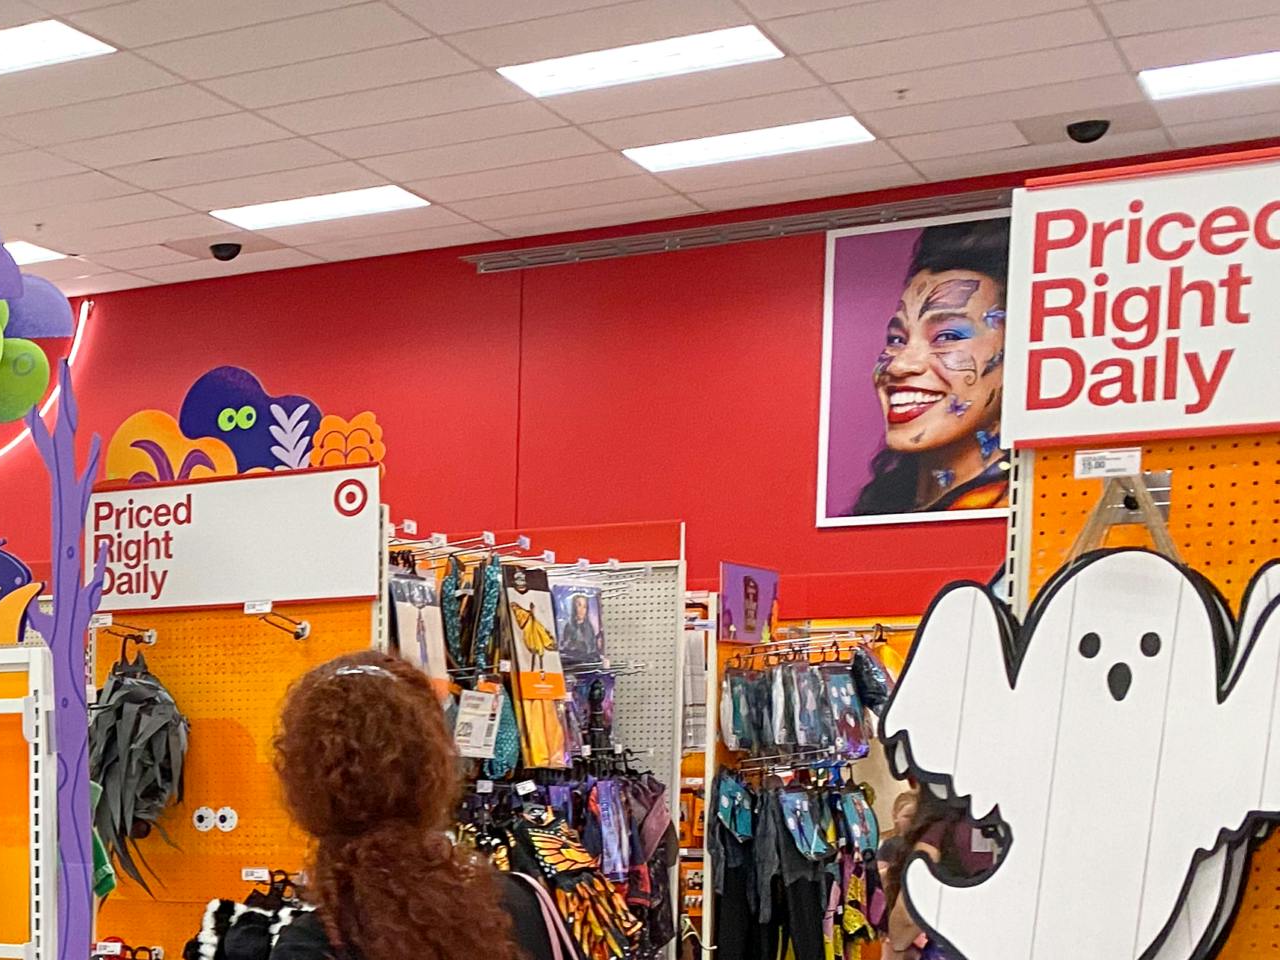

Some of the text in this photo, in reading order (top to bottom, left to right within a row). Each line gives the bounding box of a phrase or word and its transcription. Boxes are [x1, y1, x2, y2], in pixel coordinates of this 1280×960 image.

[1029, 263, 1252, 350] Right
[1026, 336, 1236, 414] Daily
[94, 493, 192, 532] Priced
[94, 531, 174, 569] Right
